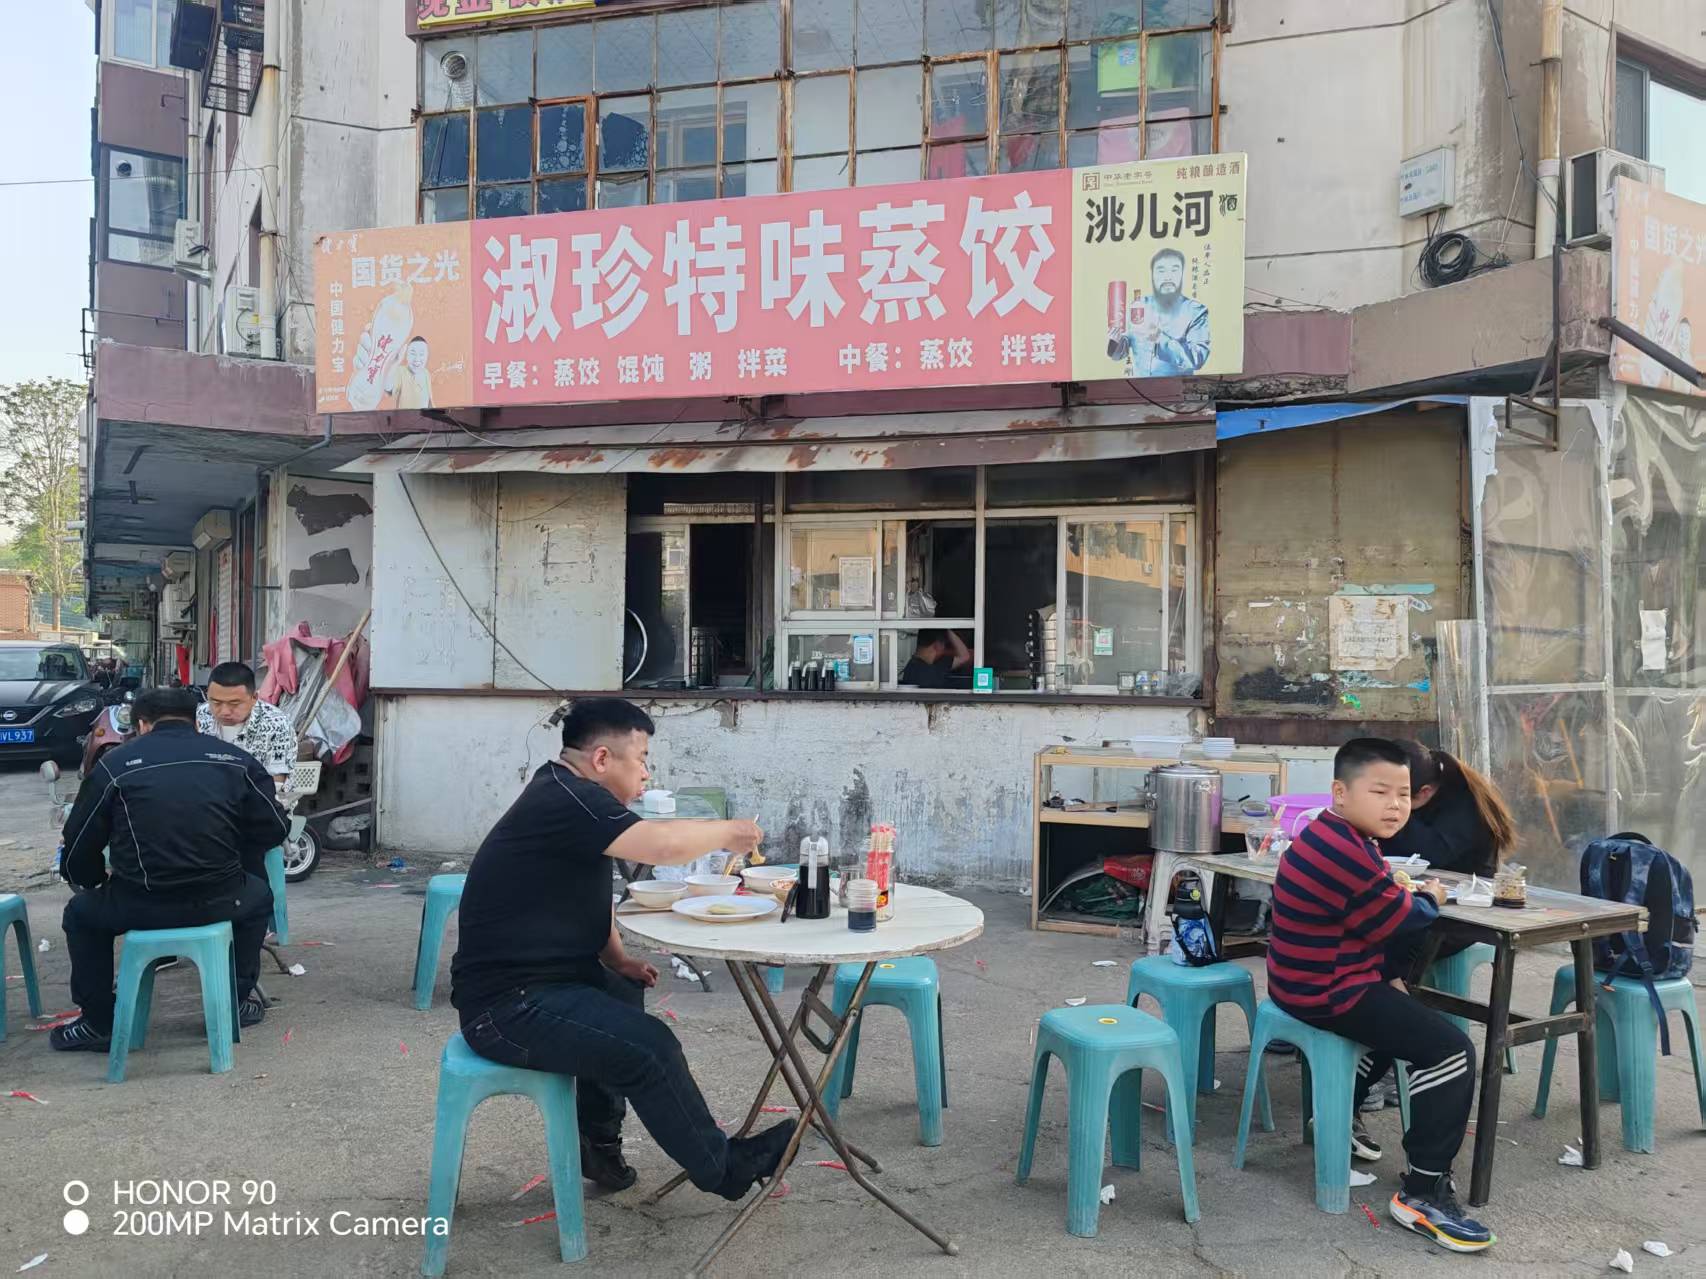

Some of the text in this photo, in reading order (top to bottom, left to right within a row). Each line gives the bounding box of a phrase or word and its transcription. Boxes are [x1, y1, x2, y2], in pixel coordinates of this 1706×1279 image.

[1176, 161, 1241, 180] 纯粮酿造酒
[1085, 190, 1214, 244] 洮儿河
[351, 249, 460, 289] 国货之光
[483, 189, 1056, 345] 淑珍特味蒸饺
[483, 360, 539, 390] 早餐：
[553, 357, 601, 388] 蒸饺
[617, 353, 665, 385] 馄饨
[689, 351, 712, 381] 粥
[738, 346, 788, 379] 拌菜
[839, 332, 1056, 375] 中餐： 蒸饺 拌菜
